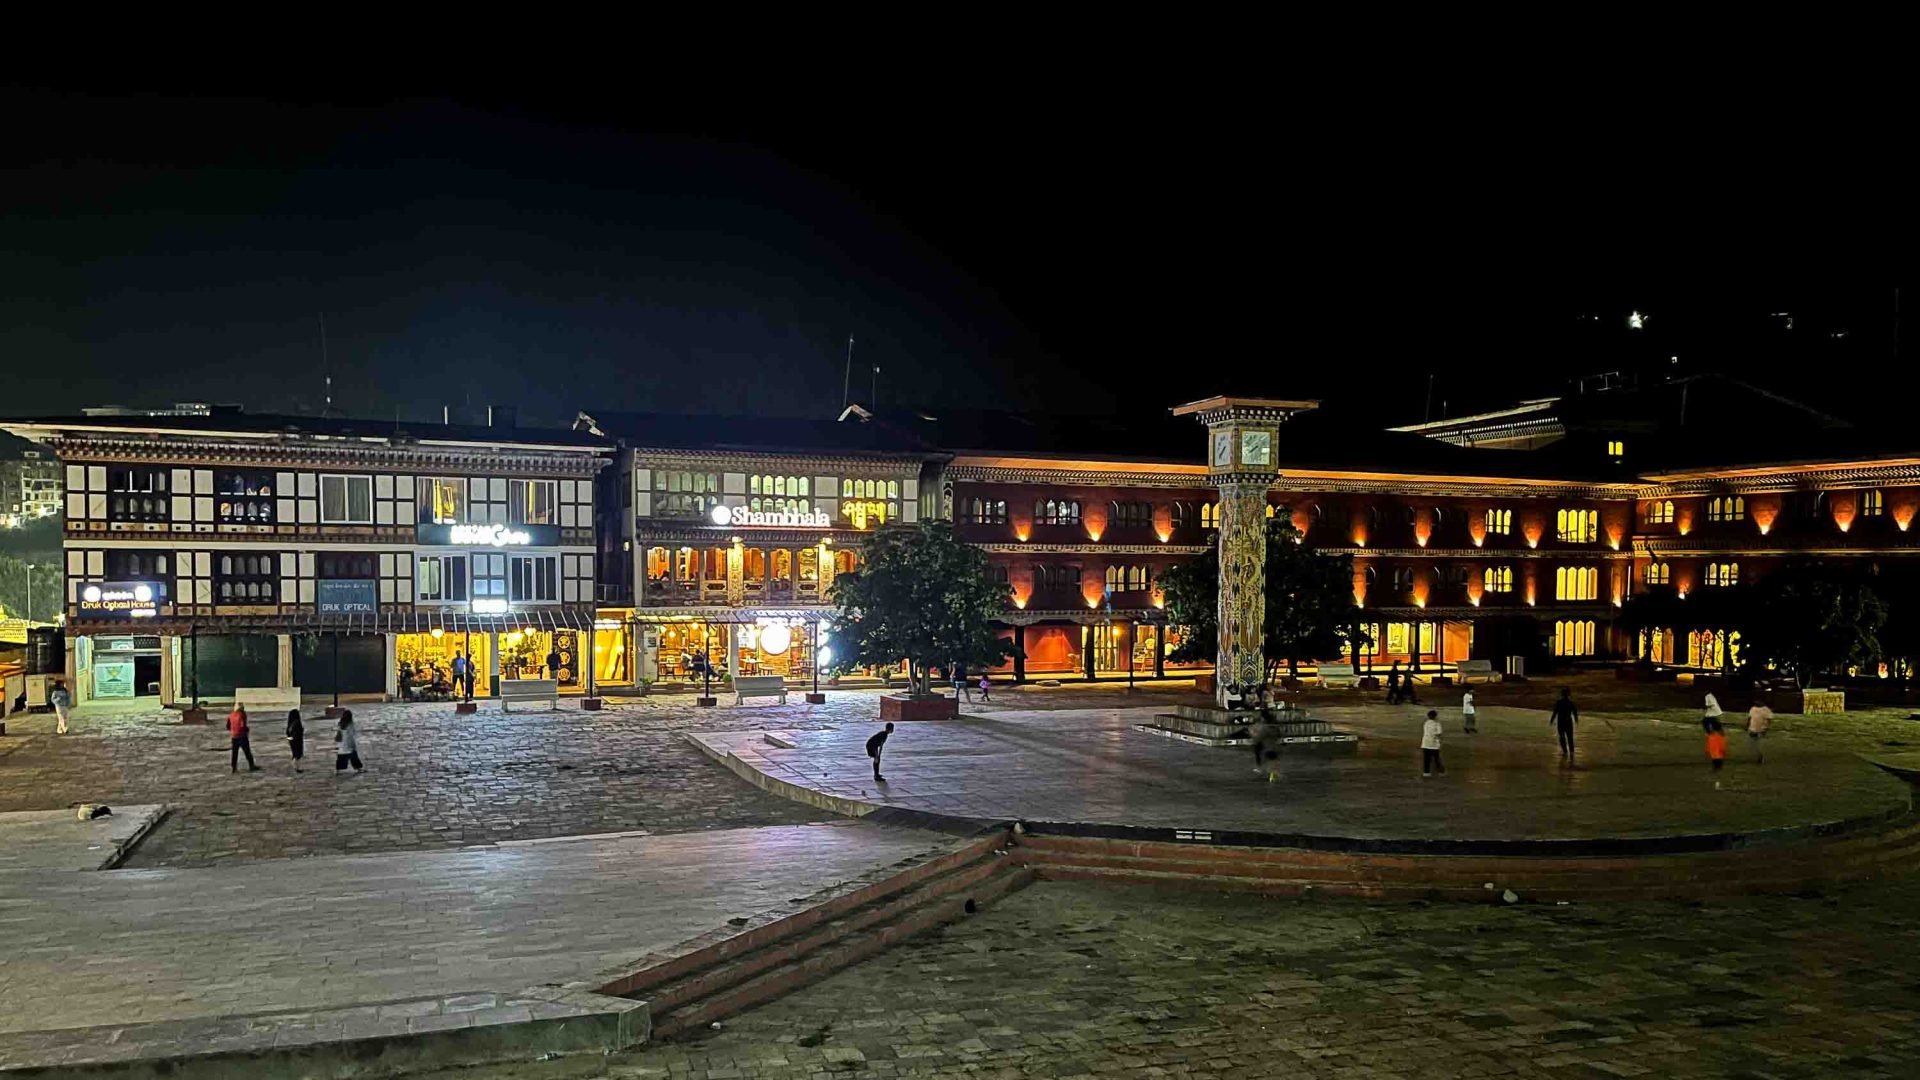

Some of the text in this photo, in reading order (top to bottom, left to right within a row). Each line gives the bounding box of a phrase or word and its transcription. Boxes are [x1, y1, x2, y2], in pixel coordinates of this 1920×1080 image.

[731, 506, 831, 527] Shambhala
[81, 601, 101, 609] Druk
[131, 600, 156, 609] House
[322, 603, 373, 611] DRUK OPTICAL
